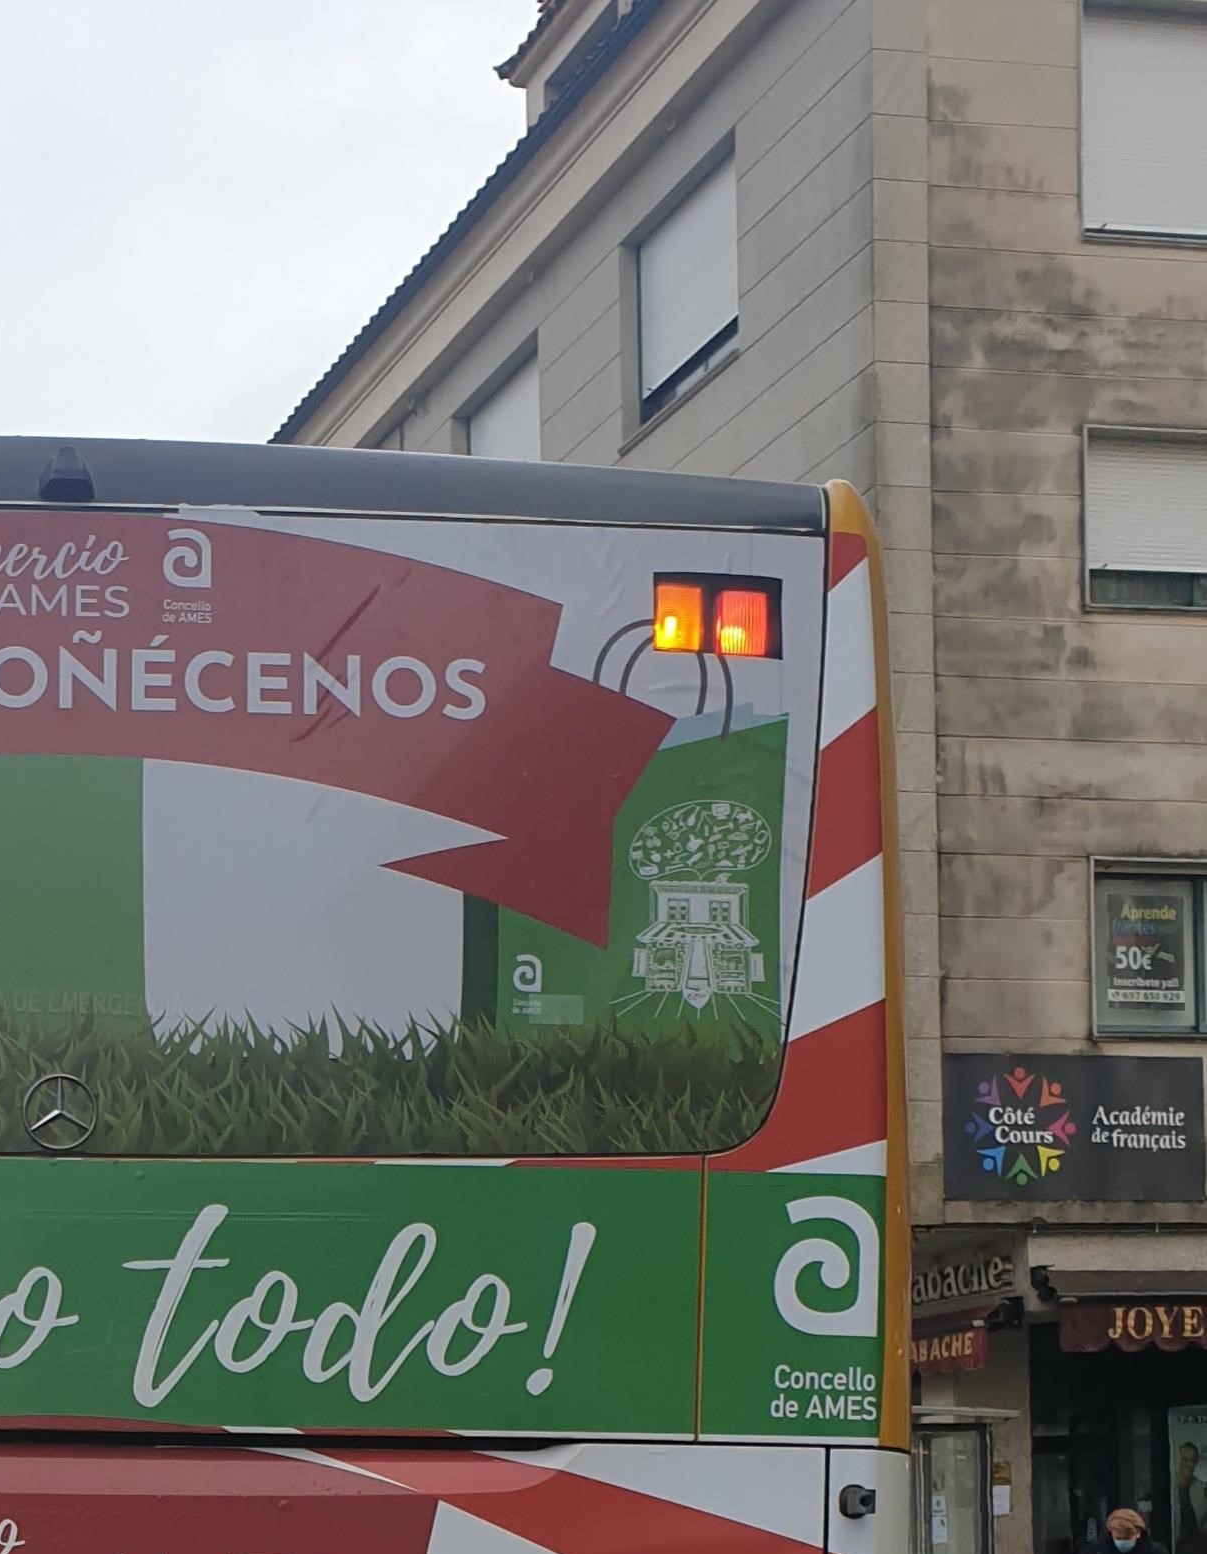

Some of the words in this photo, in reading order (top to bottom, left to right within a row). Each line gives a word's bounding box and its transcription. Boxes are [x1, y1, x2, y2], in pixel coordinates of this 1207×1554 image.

[163, 598, 211, 612] Concello
[162, 611, 176, 623] de
[178, 611, 212, 624] AMES
[1120, 902, 1177, 921] Aprende
[1115, 946, 1152, 970] 50€
[12, 988, 42, 1014] DE
[988, 1106, 1035, 1125] Côté
[1093, 1105, 1185, 1127] Académie
[995, 1126, 1054, 1144] Cours
[1091, 1127, 1109, 1144] de
[1111, 1128, 1186, 1152] français
[122, 1204, 597, 1408] todo!
[1107, 1306, 1205, 1341] JOYE
[774, 1364, 877, 1391] Concello
[770, 1393, 799, 1418] de
[805, 1395, 878, 1421] AMES
